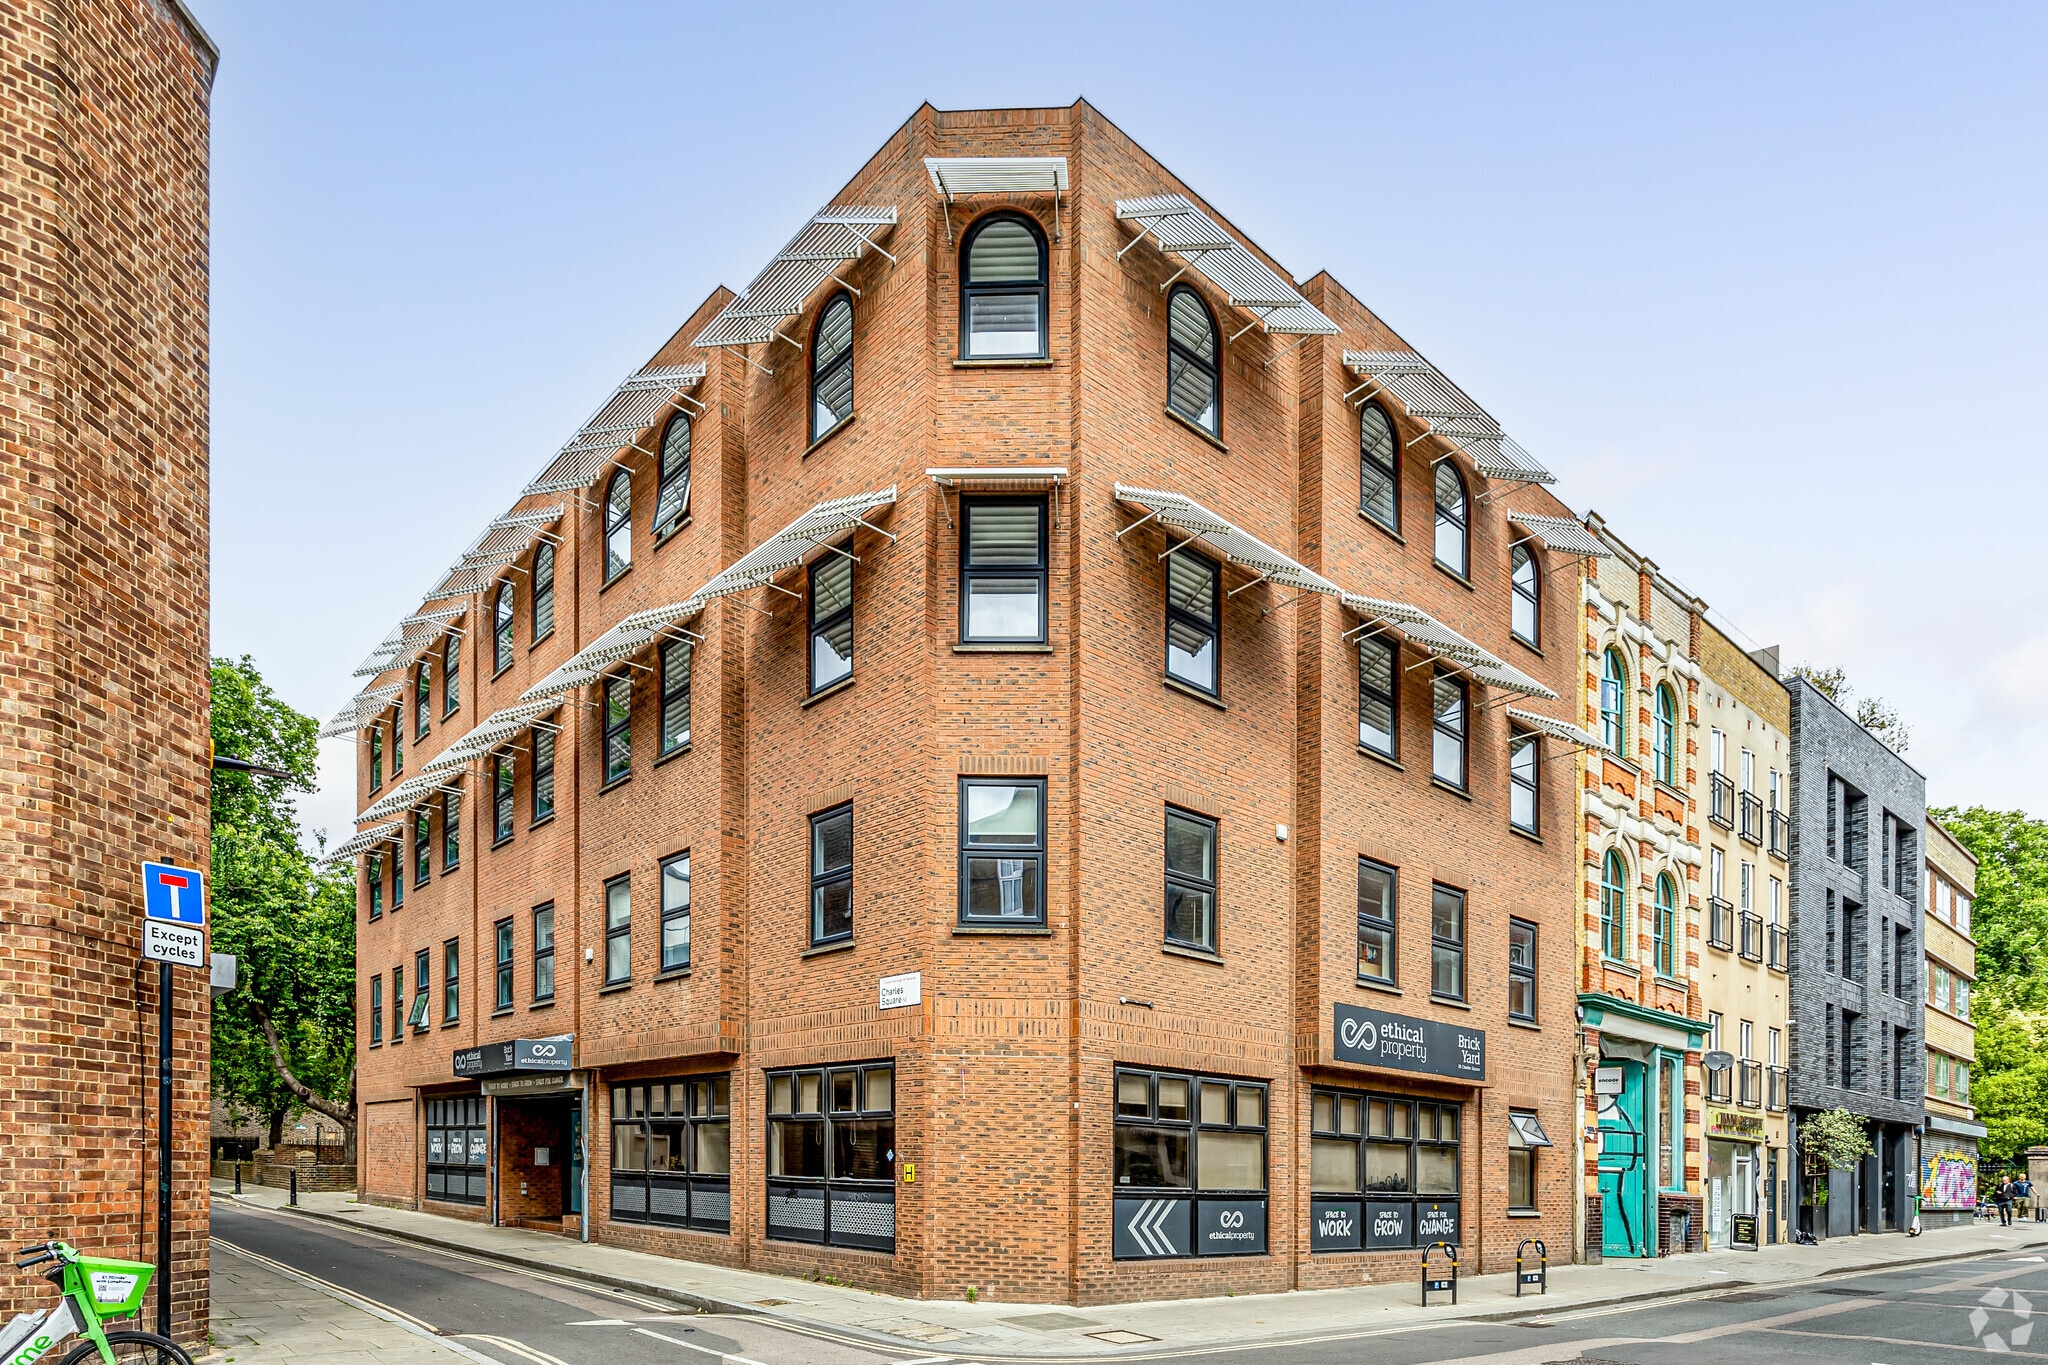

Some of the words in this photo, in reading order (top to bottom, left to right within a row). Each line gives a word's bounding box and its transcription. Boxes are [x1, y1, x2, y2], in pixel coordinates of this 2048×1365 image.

[151, 926, 198, 946] Except
[153, 944, 195, 959] cycles
[881, 987, 904, 997] Charles
[881, 996, 902, 1006] Square
[1381, 1022, 1424, 1043] ethical
[1381, 1039, 1427, 1063] property
[1458, 1034, 1480, 1051] Brick
[466, 1050, 481, 1061] ethical
[1461, 1049, 1480, 1066] Yard
[905, 1166, 913, 1180] H
[1325, 1210, 1339, 1219] SPACE
[1340, 1210, 1347, 1218] TO
[1379, 1211, 1392, 1219] SPACE
[1318, 1219, 1353, 1238] WORK
[1374, 1219, 1403, 1237] GROW
[1419, 1218, 1455, 1235] CHANGE
